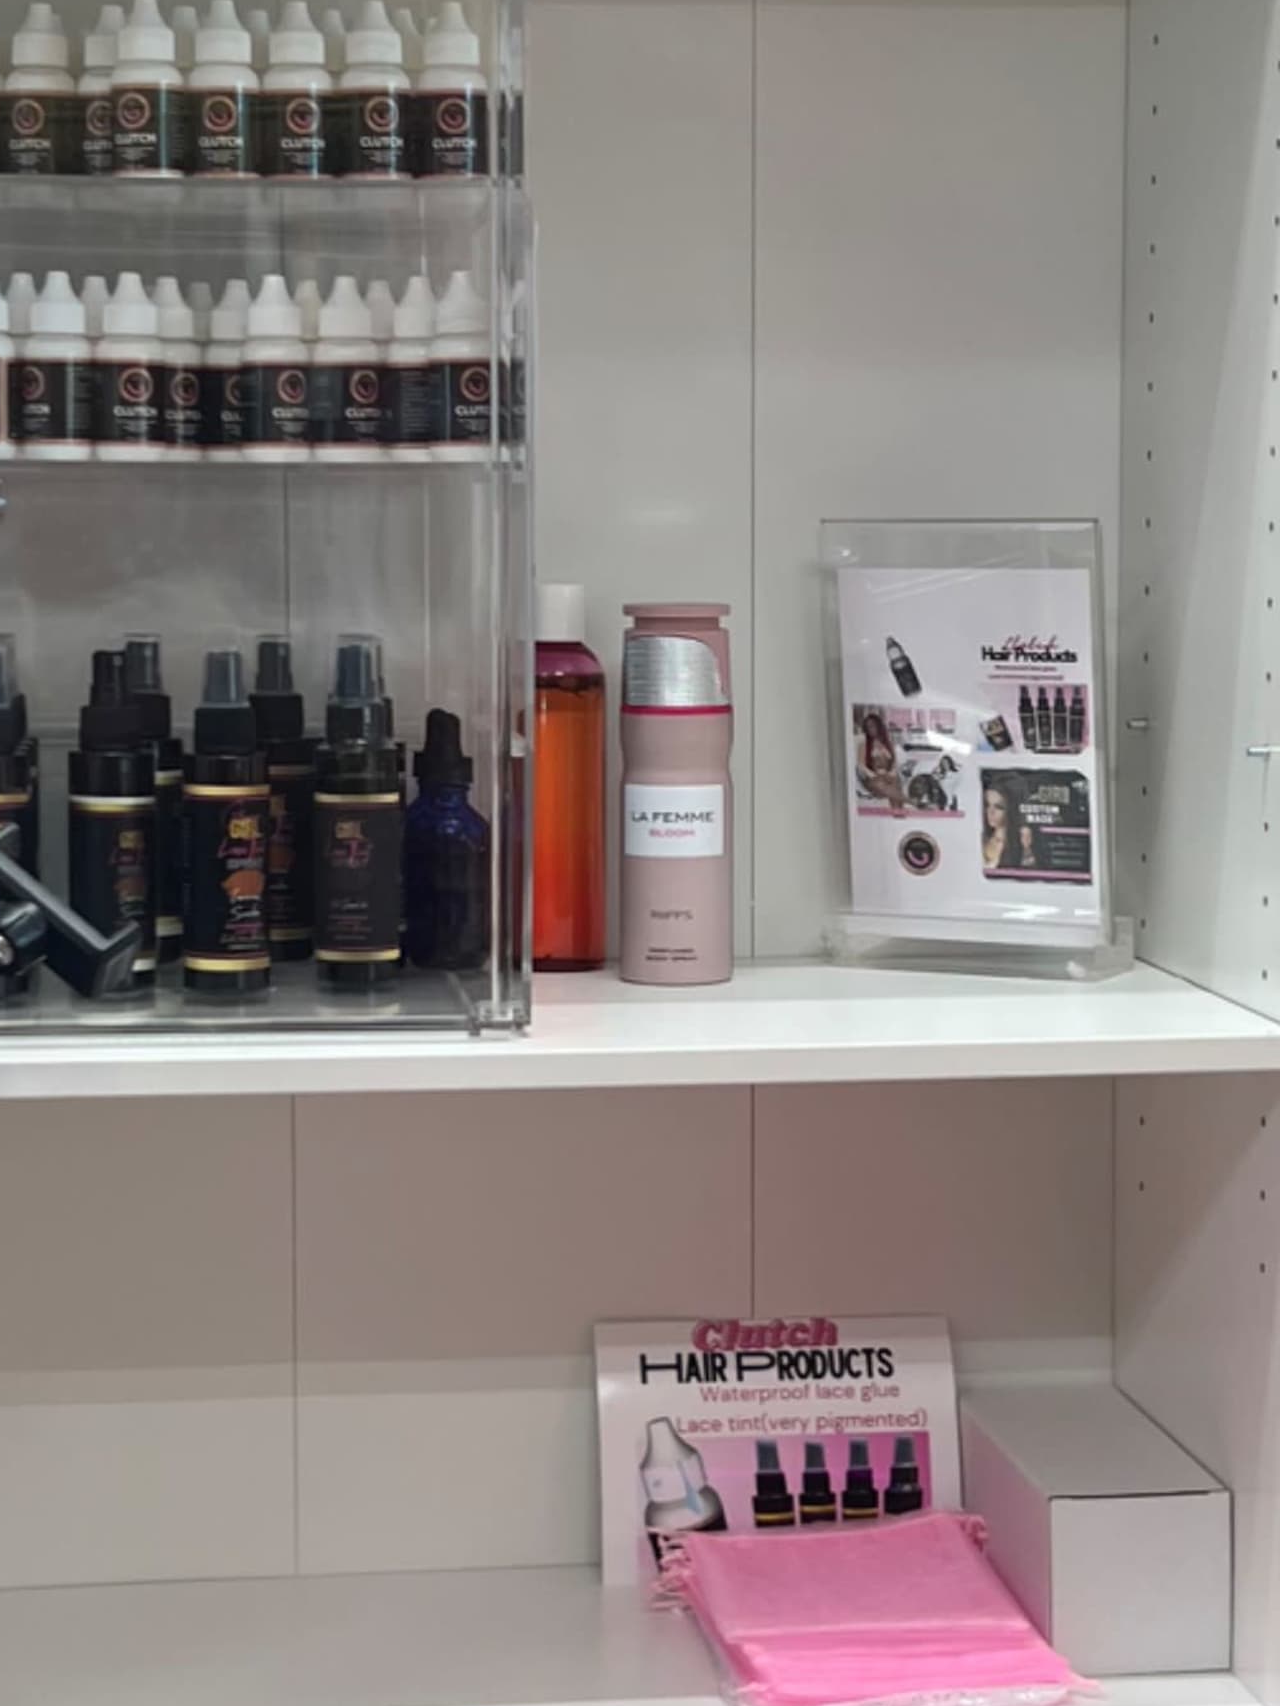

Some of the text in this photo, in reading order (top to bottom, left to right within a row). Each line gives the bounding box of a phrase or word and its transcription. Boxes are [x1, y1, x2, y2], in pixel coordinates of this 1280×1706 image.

[981, 646, 1078, 663] Hair Products
[631, 811, 715, 824] LA FEMME
[692, 1317, 838, 1352] Clutch
[639, 1348, 895, 1385] HAIR PRODUCTS
[699, 1382, 900, 1405] Waterproof lace glue
[676, 1417, 723, 1434] Lace
[815, 1408, 928, 1434] pigmented)
